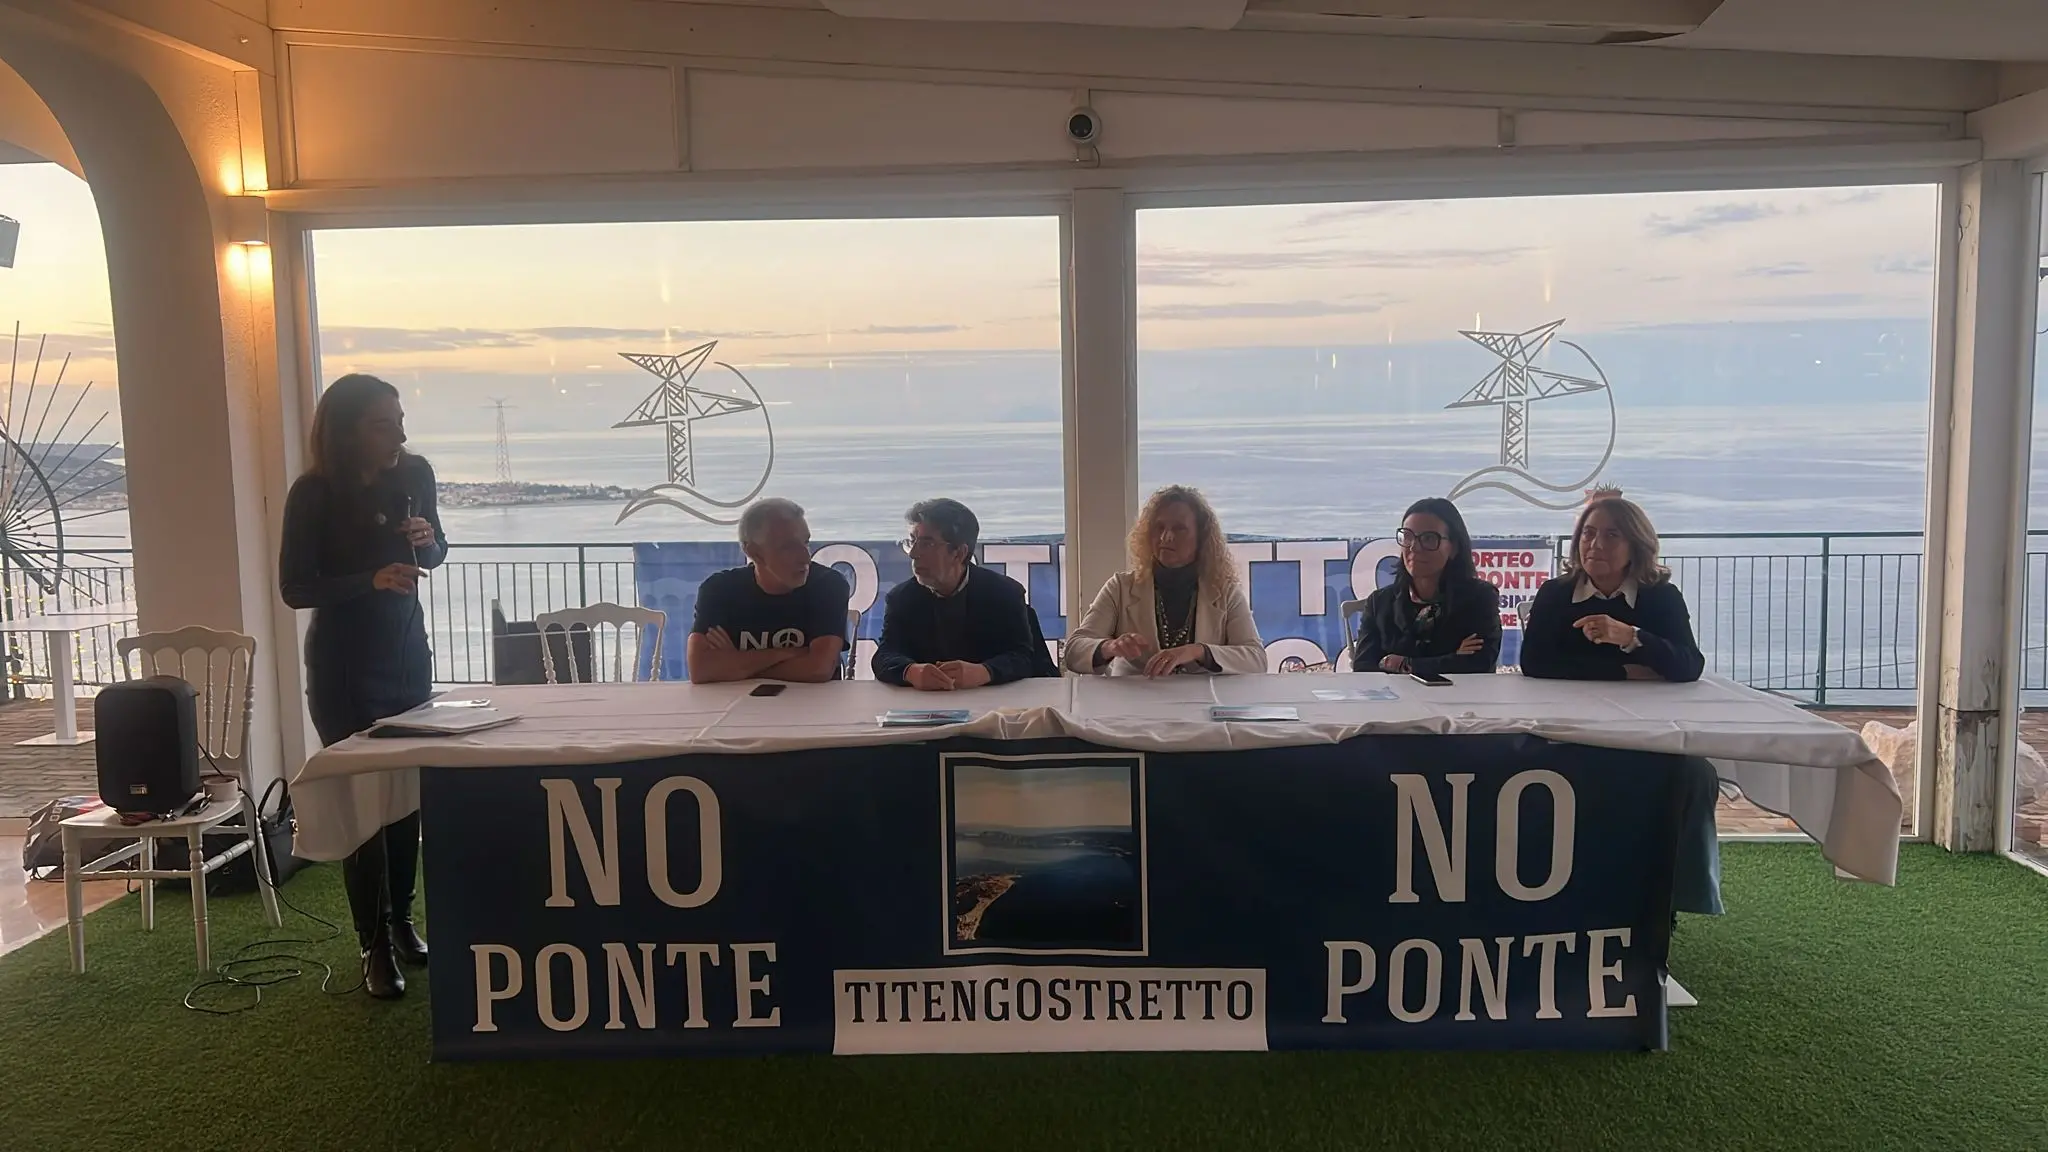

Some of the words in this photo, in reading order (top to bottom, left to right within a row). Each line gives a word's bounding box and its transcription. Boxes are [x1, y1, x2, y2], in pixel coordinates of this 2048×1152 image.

[1471, 551, 1534, 568] ORTEO
[740, 628, 805, 651] NO
[540, 776, 723, 908] NO
[1388, 769, 1577, 903] NO
[470, 942, 781, 1032] PONTE
[845, 977, 1254, 1023] TITENGOSTRETTO
[1322, 927, 1638, 1023] PONTE
